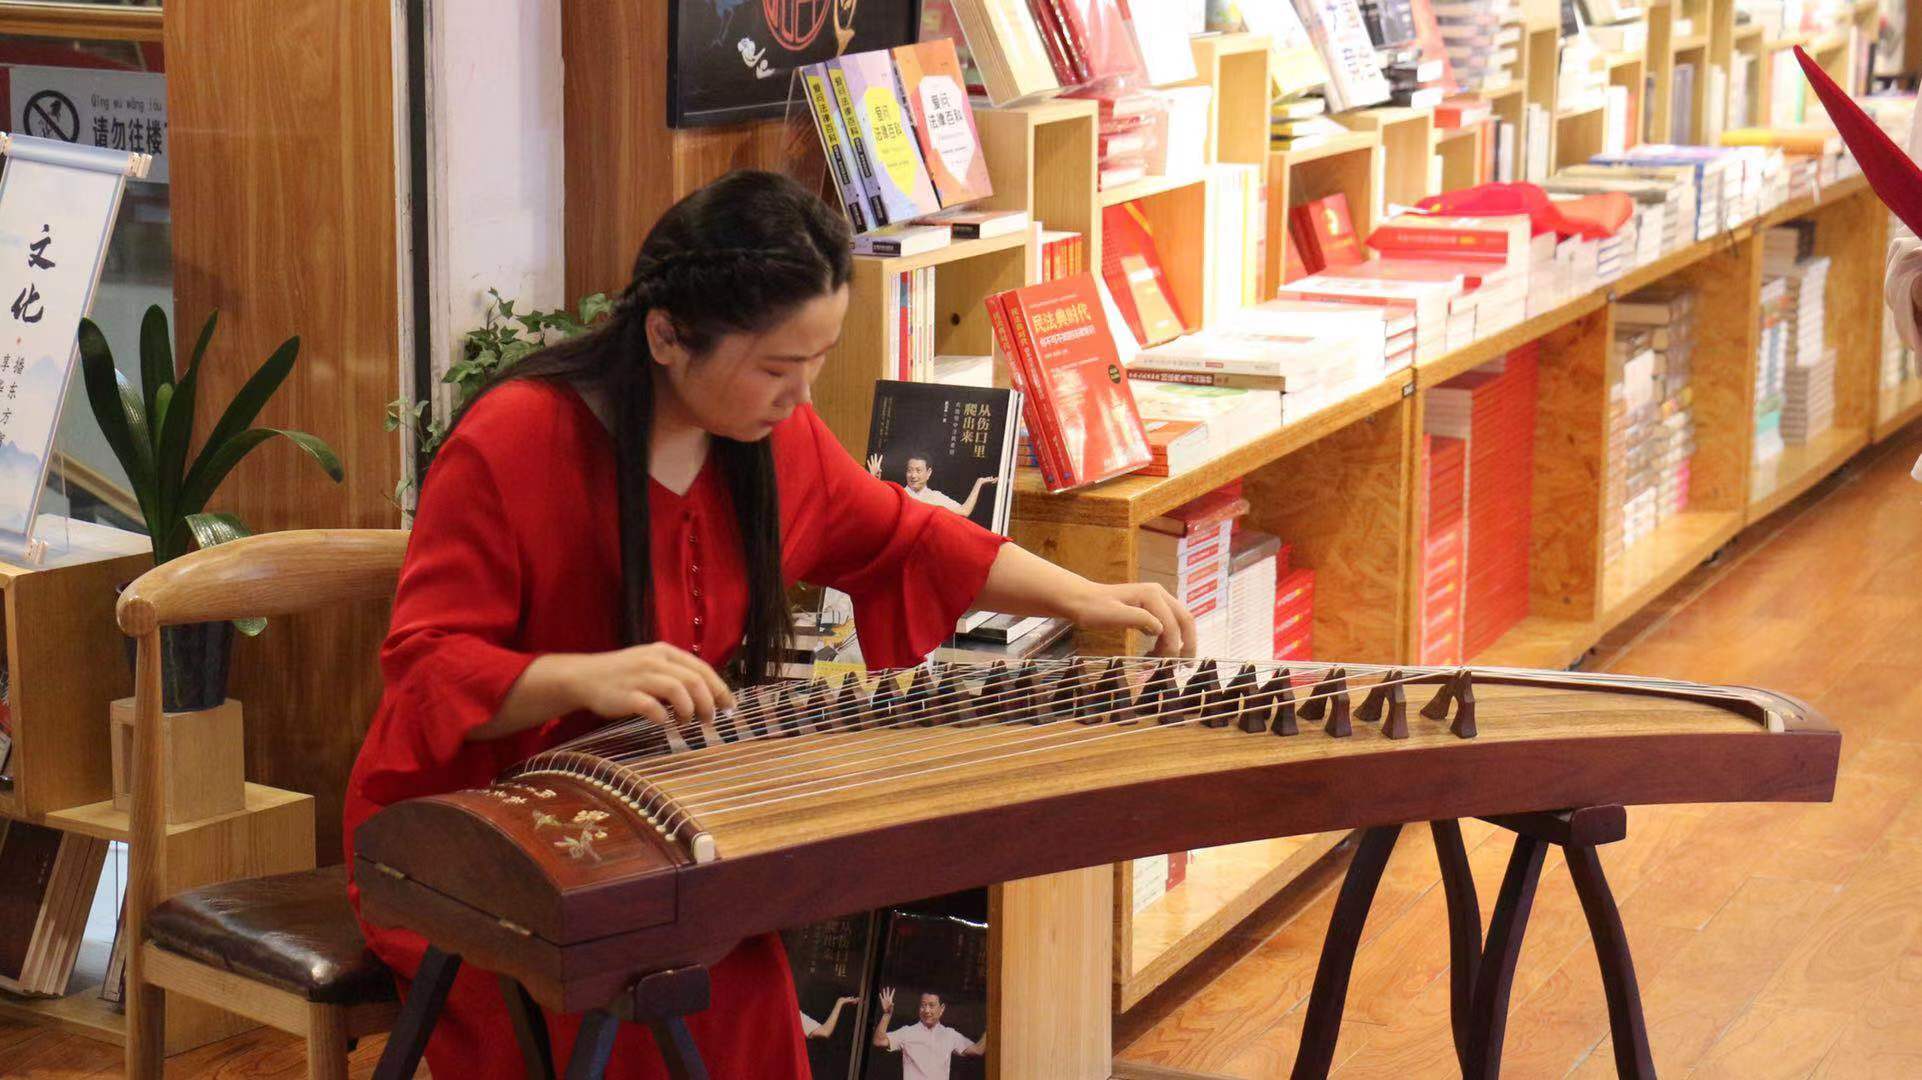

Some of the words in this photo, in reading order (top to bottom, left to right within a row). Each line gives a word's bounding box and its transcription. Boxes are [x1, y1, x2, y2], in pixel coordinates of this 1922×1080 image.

[93, 116, 167, 154] 请勿往楼
[11, 223, 56, 323] 文化
[1032, 303, 1092, 333] 民法典时代
[961, 402, 977, 443] 爬出来
[974, 403, 991, 458] 从伤口里
